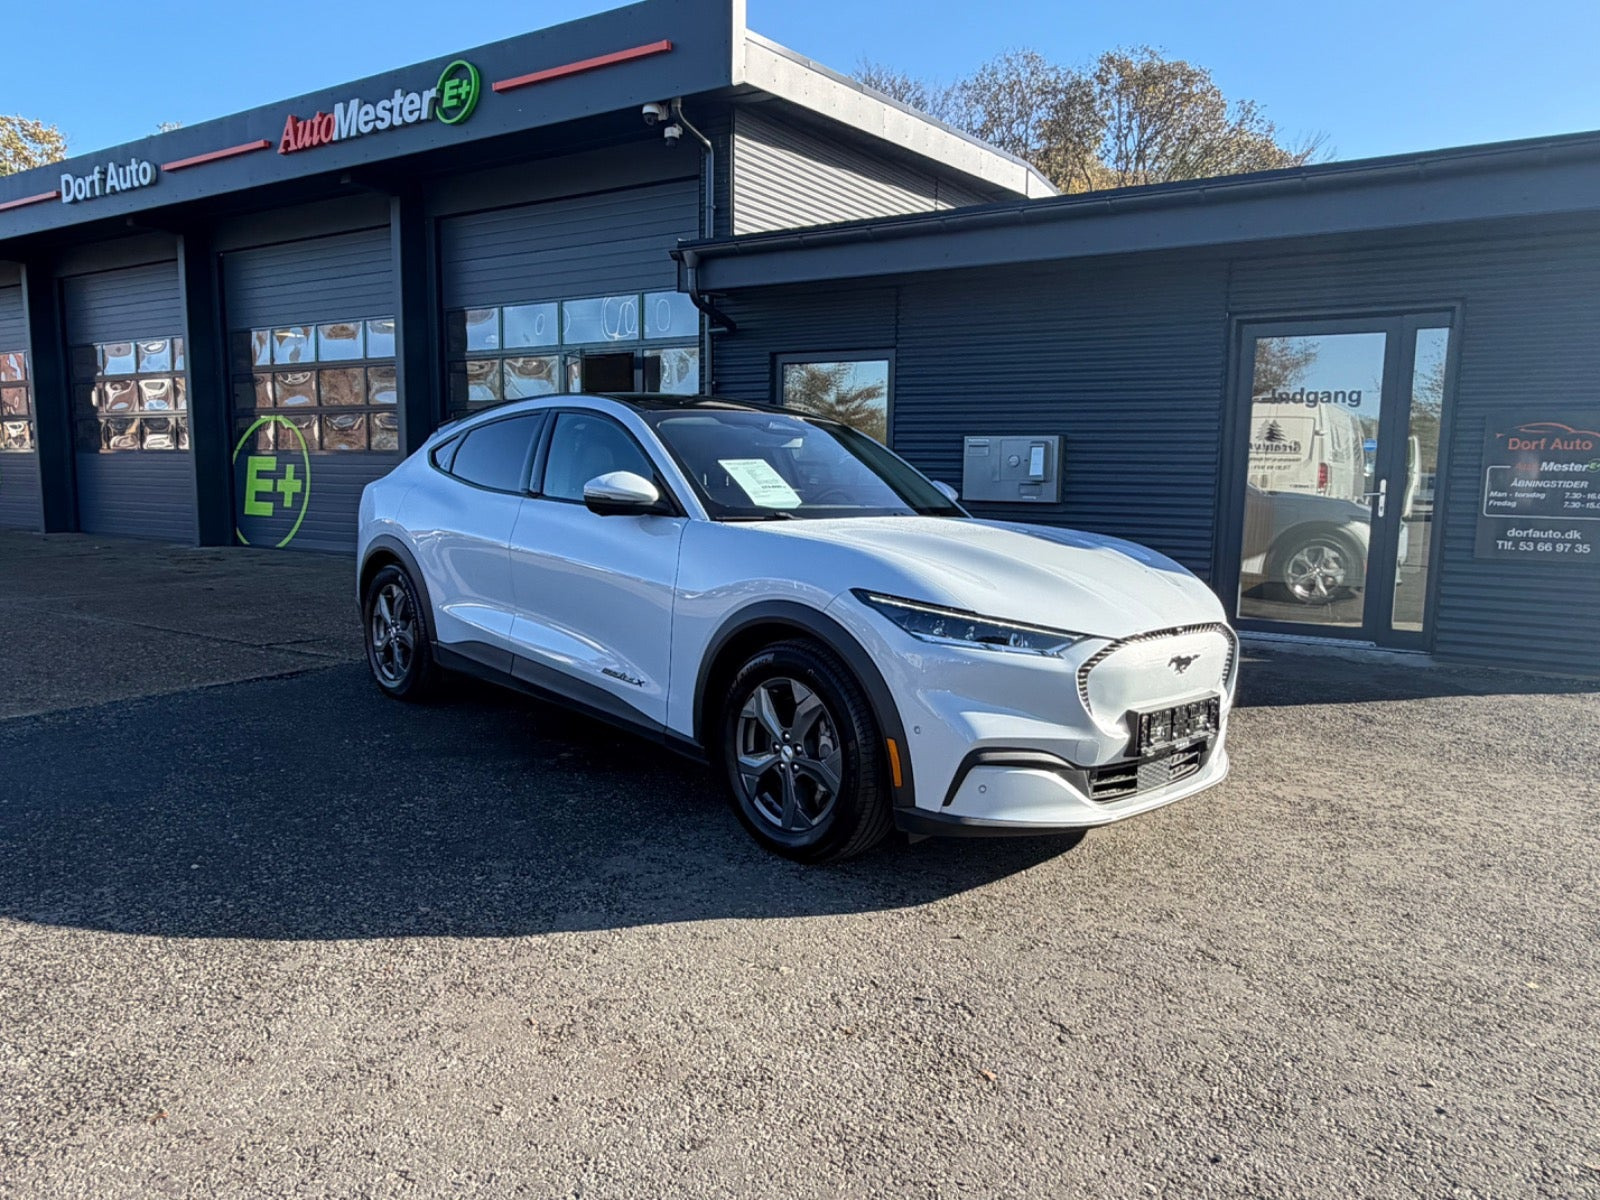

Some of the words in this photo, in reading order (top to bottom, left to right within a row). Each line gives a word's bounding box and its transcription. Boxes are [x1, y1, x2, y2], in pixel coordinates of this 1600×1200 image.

[60, 165, 102, 204] Dorf
[106, 158, 154, 194] Auto
[1271, 387, 1362, 408] Indgang
[1507, 437, 1547, 451] Dorf
[1550, 438, 1593, 451] Auto
[244, 455, 302, 517] E+
[1510, 477, 1589, 489] ÅBNINGSTIDER
[1489, 490, 1508, 498] Man
[1514, 491, 1546, 500] torsdag
[1488, 499, 1517, 508] Fredag
[1506, 528, 1582, 540] dorfauto.dk
[1496, 540, 1516, 551] Tlf.
[1518, 541, 1534, 551] 53
[1537, 541, 1553, 552] 66
[1556, 542, 1572, 553] 97
[1574, 543, 1591, 554] 35
